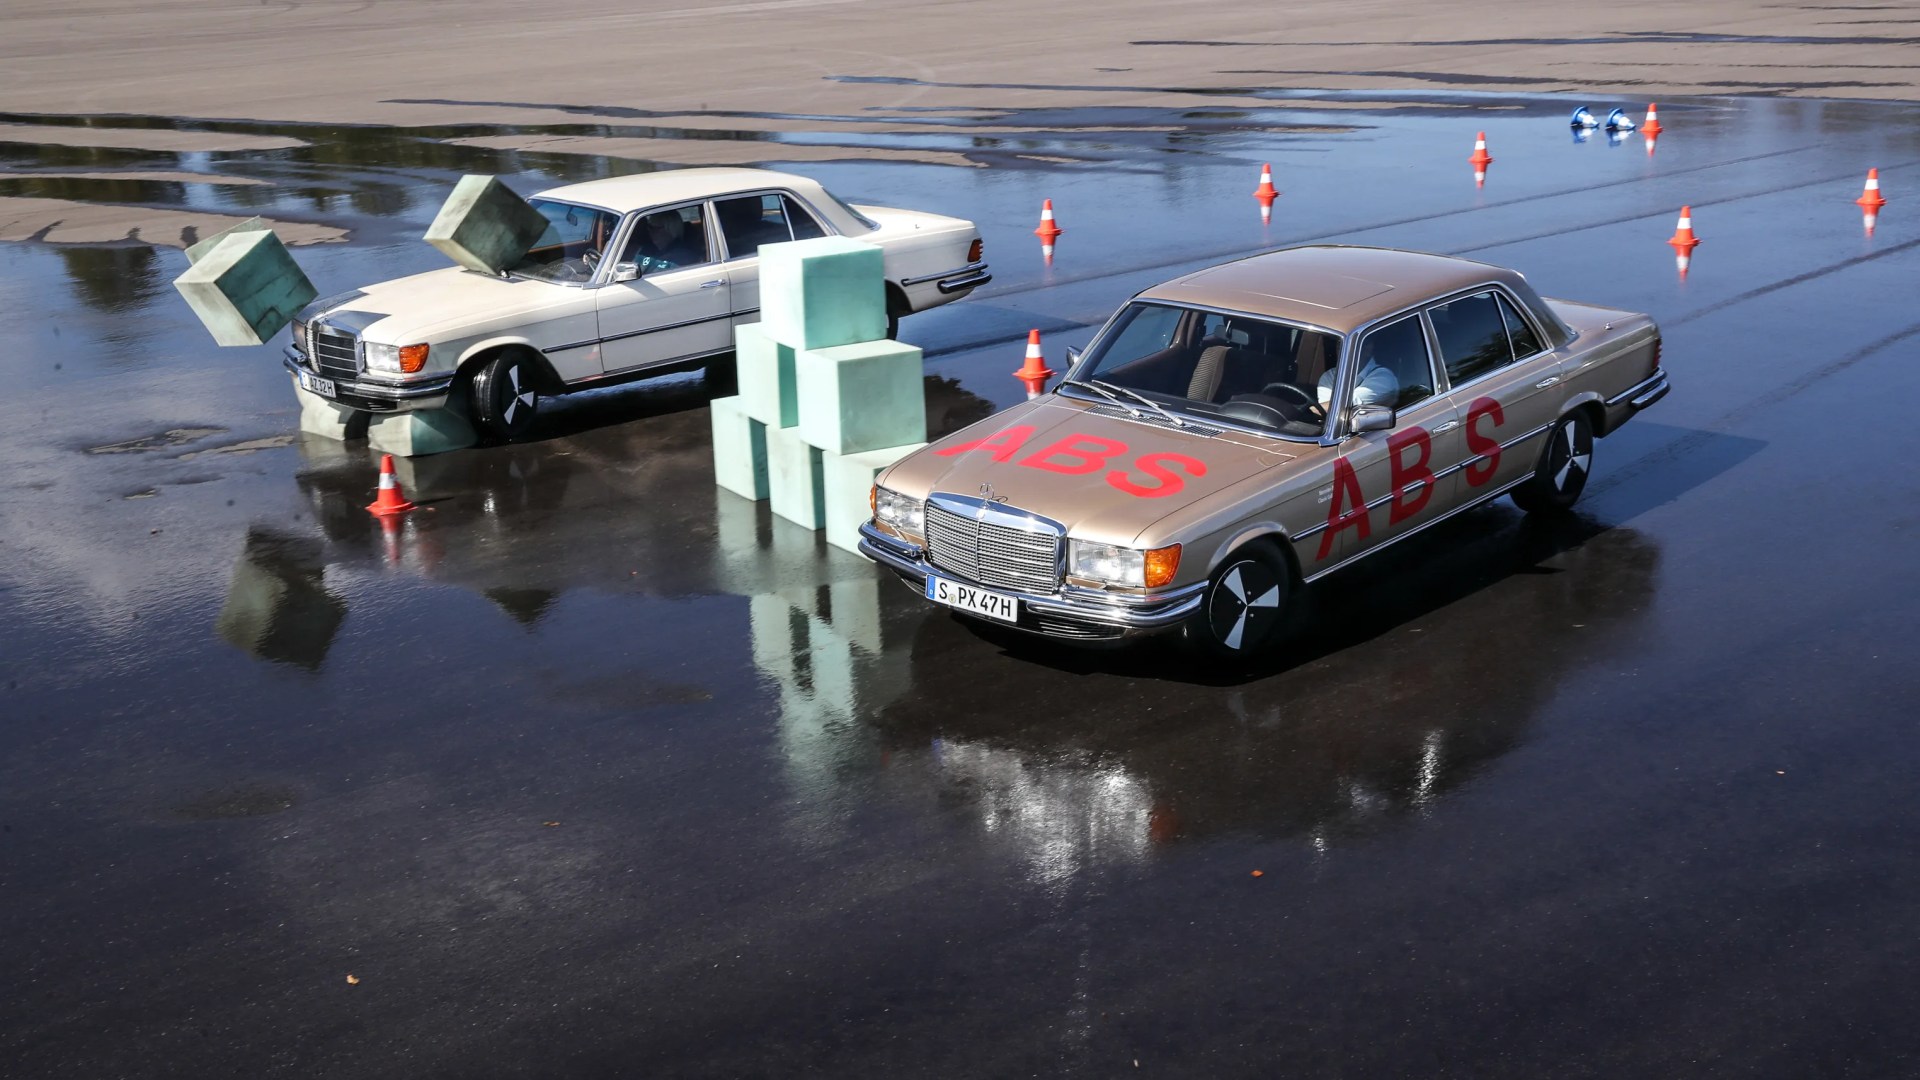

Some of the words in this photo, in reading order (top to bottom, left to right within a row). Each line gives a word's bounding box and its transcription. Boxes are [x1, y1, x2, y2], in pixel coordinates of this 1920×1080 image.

[932, 425, 1208, 499] ABS
[1315, 396, 1505, 562] ABS
[939, 582, 948, 600] S
[958, 586, 977, 608] PX
